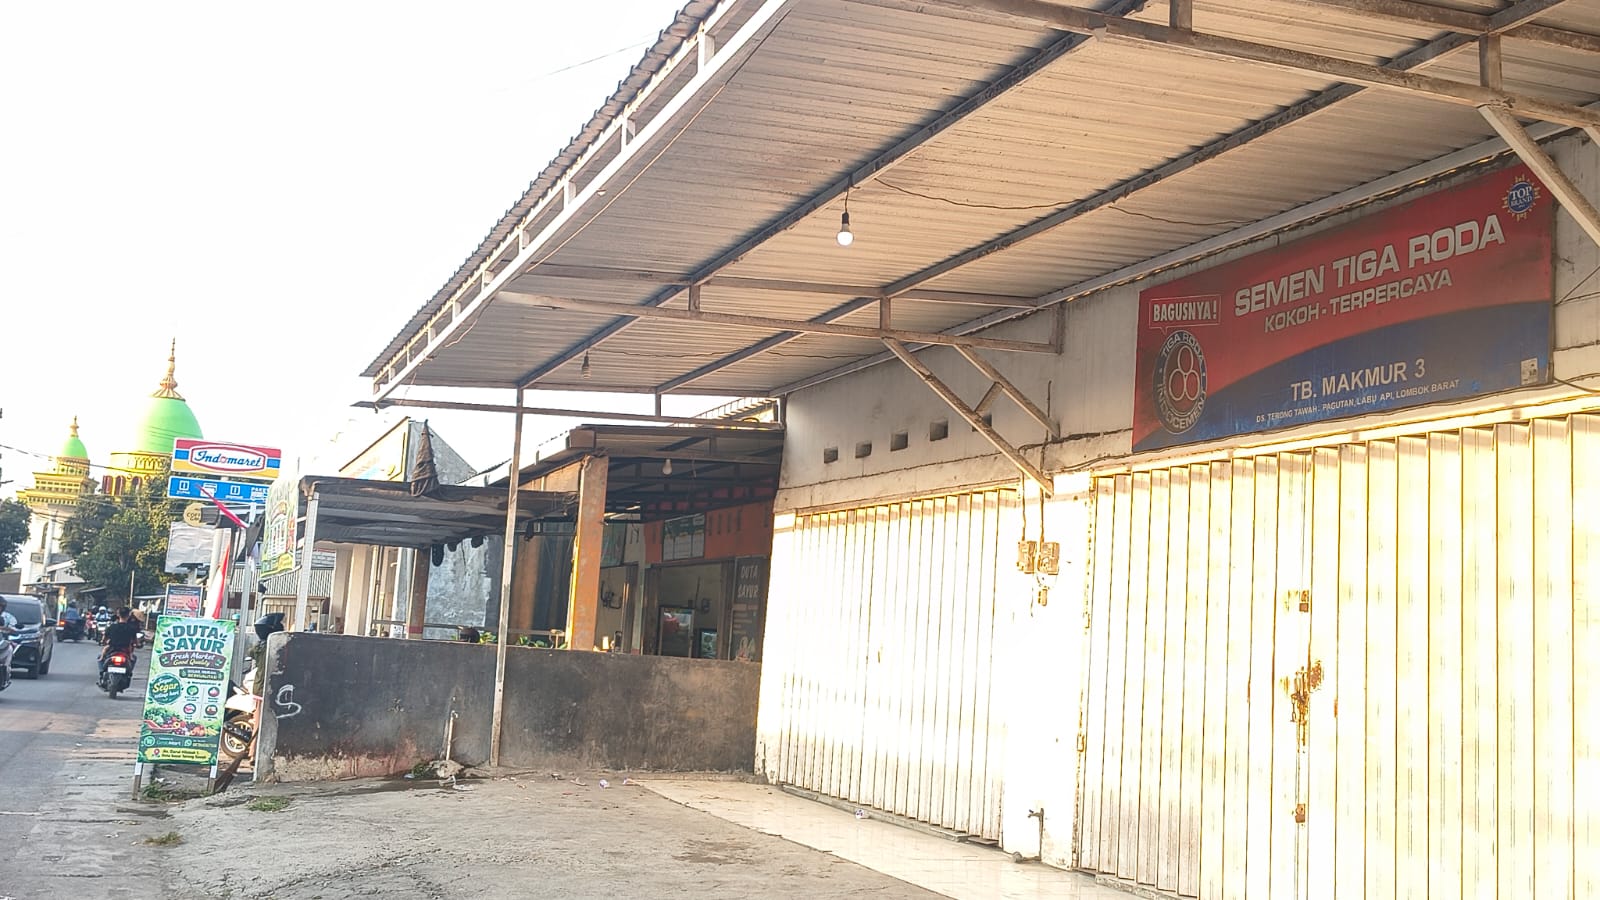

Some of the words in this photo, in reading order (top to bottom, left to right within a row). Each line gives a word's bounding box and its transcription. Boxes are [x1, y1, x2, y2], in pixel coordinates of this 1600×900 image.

[1510, 186, 1532, 200] TOP
[1234, 265, 1325, 317] SEMEN
[1332, 245, 1400, 288] TIGA
[1408, 214, 1505, 268] RODA
[1264, 302, 1320, 333] KOKOH
[1329, 268, 1452, 316] TERPERCAYA
[1153, 300, 1217, 322] BAGUSNYA!
[1162, 333, 1182, 358] TIGA
[1182, 332, 1205, 362] RODA
[1291, 380, 1317, 402] TB.
[1322, 361, 1408, 396] MAKMUR
[1414, 358, 1426, 378] 3
[1267, 409, 1293, 420] TERONG
[1356, 394, 1377, 405] LABU
[1396, 386, 1430, 399] LOMBOK
[1431, 379, 1460, 392] BARAT
[194, 450, 262, 467] Indomaret
[737, 584, 759, 599] SAYUR
[172, 624, 219, 639] DUTA
[163, 637, 225, 654] SAYUR
[189, 659, 210, 667] Quality
[190, 653, 215, 661] Market
[152, 682, 178, 693] Segar
